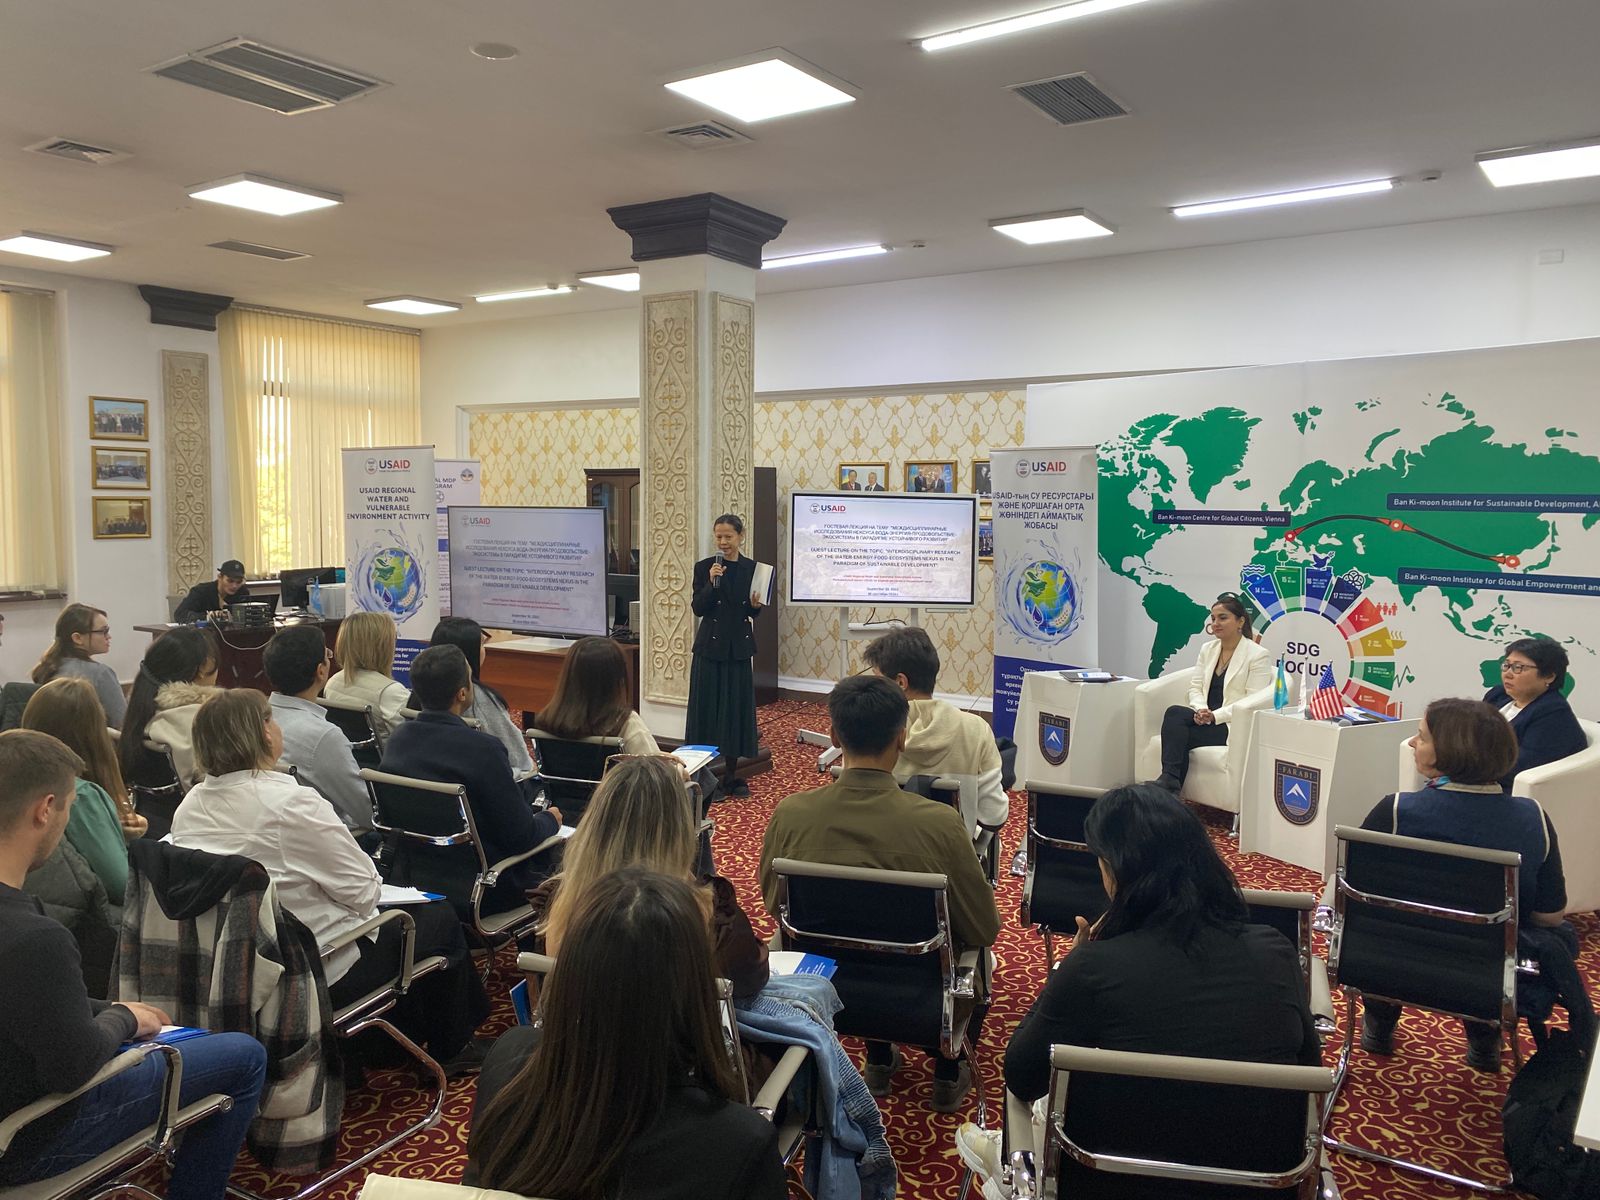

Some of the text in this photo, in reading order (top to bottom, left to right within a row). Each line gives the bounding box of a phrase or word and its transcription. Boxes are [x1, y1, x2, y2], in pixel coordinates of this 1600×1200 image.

[379, 460, 411, 469] USAID
[1032, 462, 1066, 472] USAID
[1030, 492, 1040, 500] СУ
[1042, 492, 1094, 500] РЕСУРСТАРЫ
[1021, 502, 1062, 510] ҚОРШАҒАН
[1534, 500, 1591, 508] Development,
[1041, 511, 1083, 521] АЙМАҚТЫҚ
[470, 517, 490, 525] USAID
[1420, 574, 1451, 582] Ki-moon
[1453, 576, 1483, 584] Institute
[1485, 577, 1496, 585] for
[1498, 578, 1523, 586] Global
[1526, 580, 1586, 590] Empowerment
[1287, 641, 1320, 656] SDG
